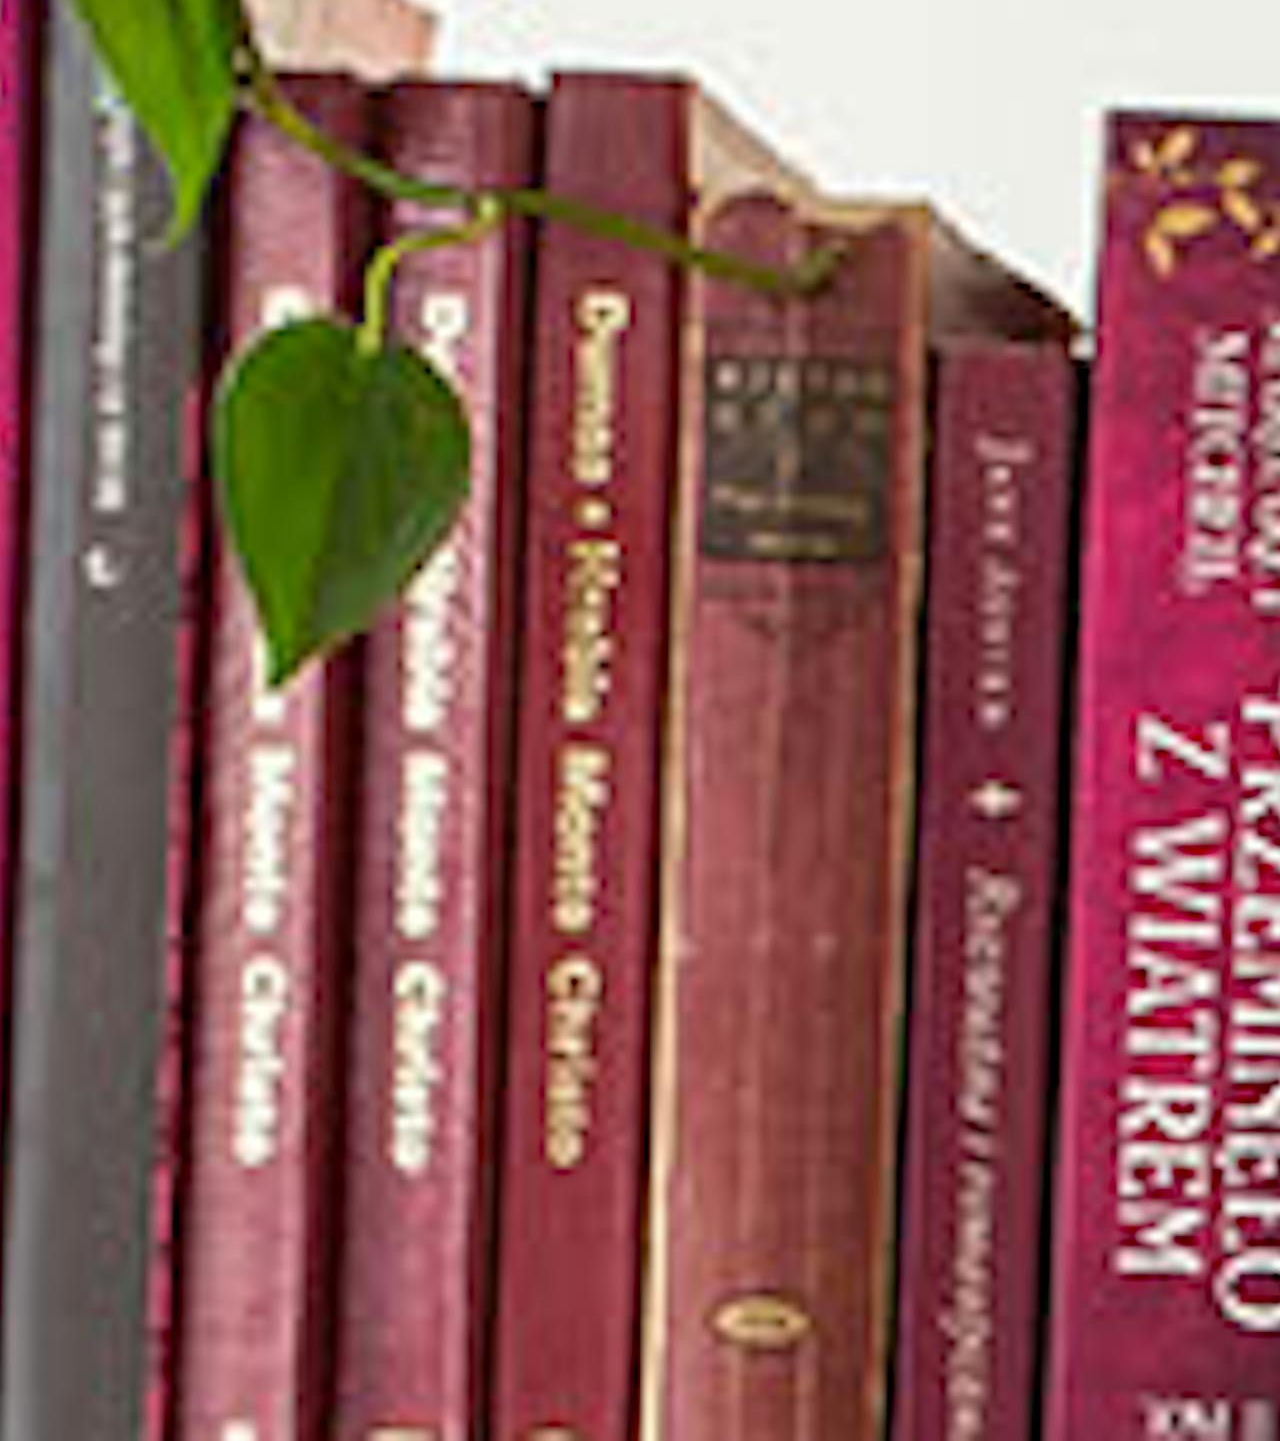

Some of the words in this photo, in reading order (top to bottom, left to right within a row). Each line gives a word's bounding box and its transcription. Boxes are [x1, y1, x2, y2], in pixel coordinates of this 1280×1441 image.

[566, 291, 629, 482] Dumas
[556, 540, 620, 721] Hrabia
[236, 744, 294, 932] Monte
[548, 747, 609, 932] Monte
[1132, 712, 1232, 783] Z
[390, 753, 451, 940] Monte
[231, 954, 289, 1167] Christo
[388, 963, 448, 1174] Christo
[542, 957, 602, 1171] Christo
[1112, 815, 1224, 1280] WIATREM
